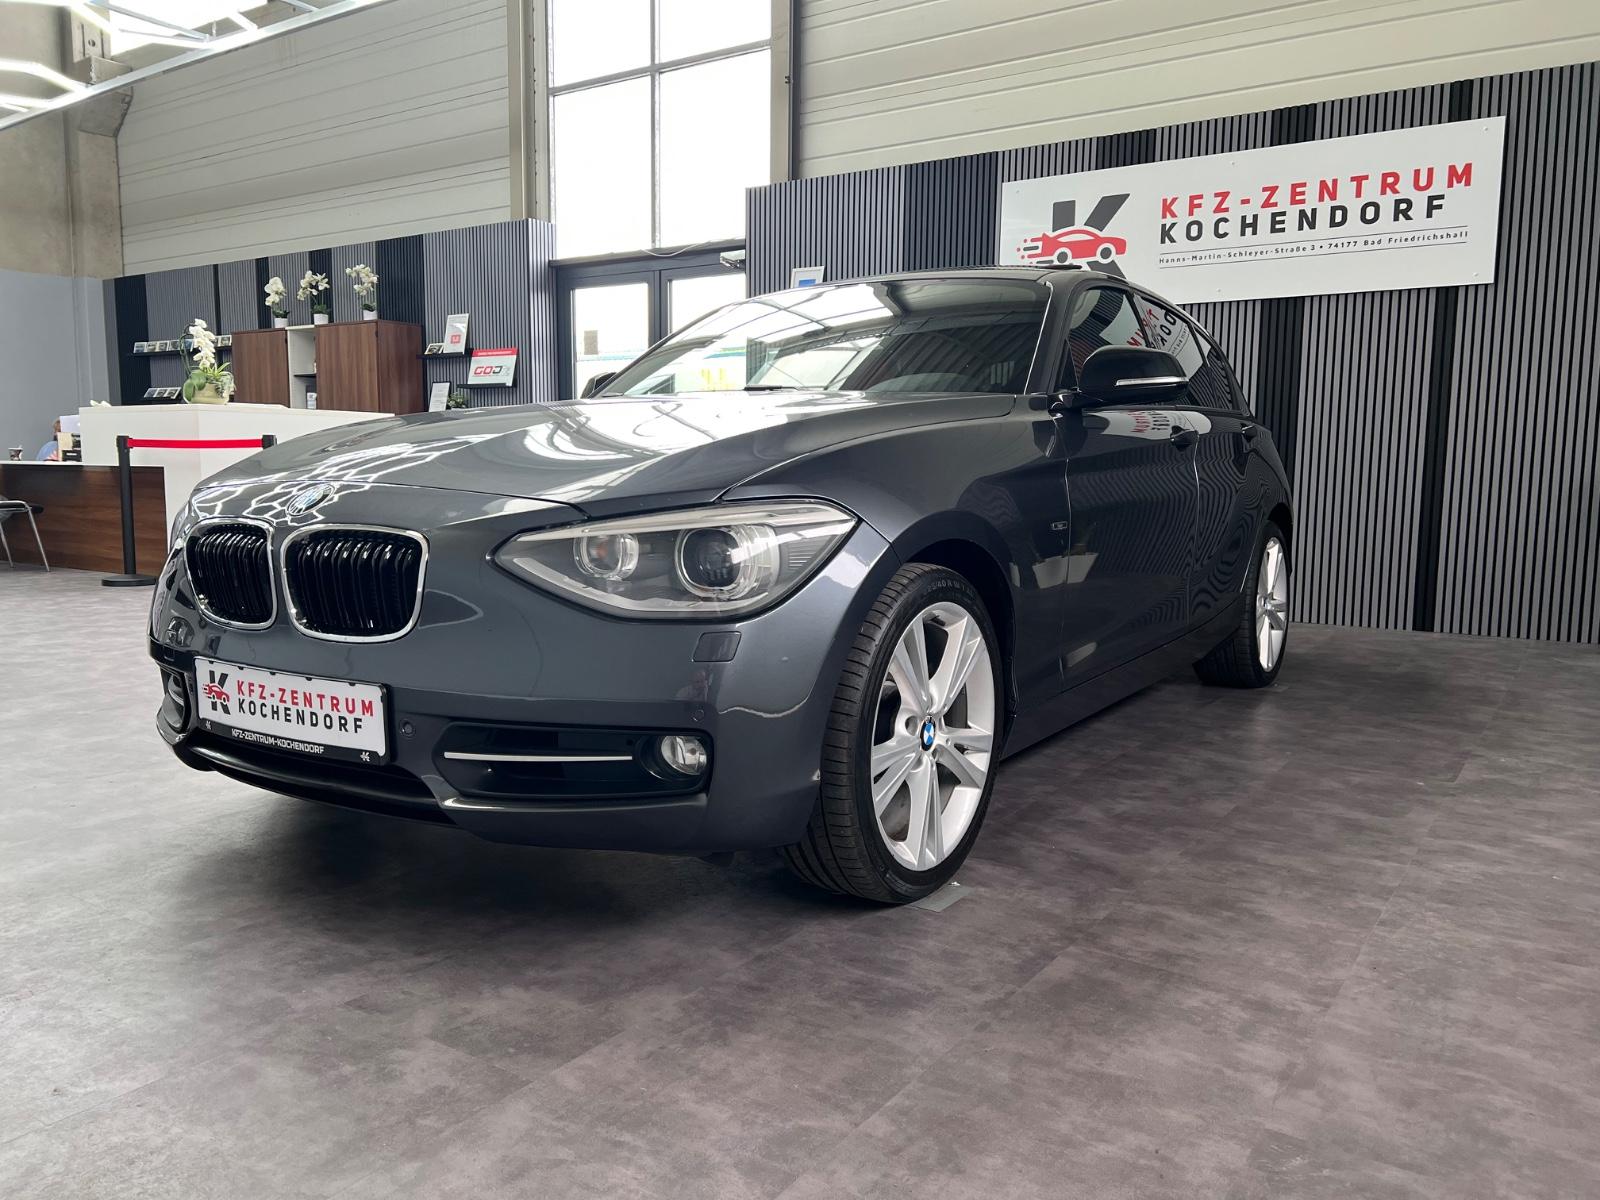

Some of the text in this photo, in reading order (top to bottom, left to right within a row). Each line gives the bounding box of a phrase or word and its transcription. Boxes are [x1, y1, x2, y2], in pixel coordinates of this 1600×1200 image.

[1161, 162, 1473, 220] KFZ-ZENTRUM
[1160, 194, 1446, 244] KOCHENDORF
[1328, 240, 1358, 249] 74177
[1363, 238, 1382, 246] Bad
[1388, 231, 1468, 244] Friedrichshall
[236, 679, 374, 717] KFZ-ZENTRUM
[238, 699, 363, 734] KOCHENDORF
[231, 728, 325, 754] KFZ-ZENTRUM-KOCHENDORF
